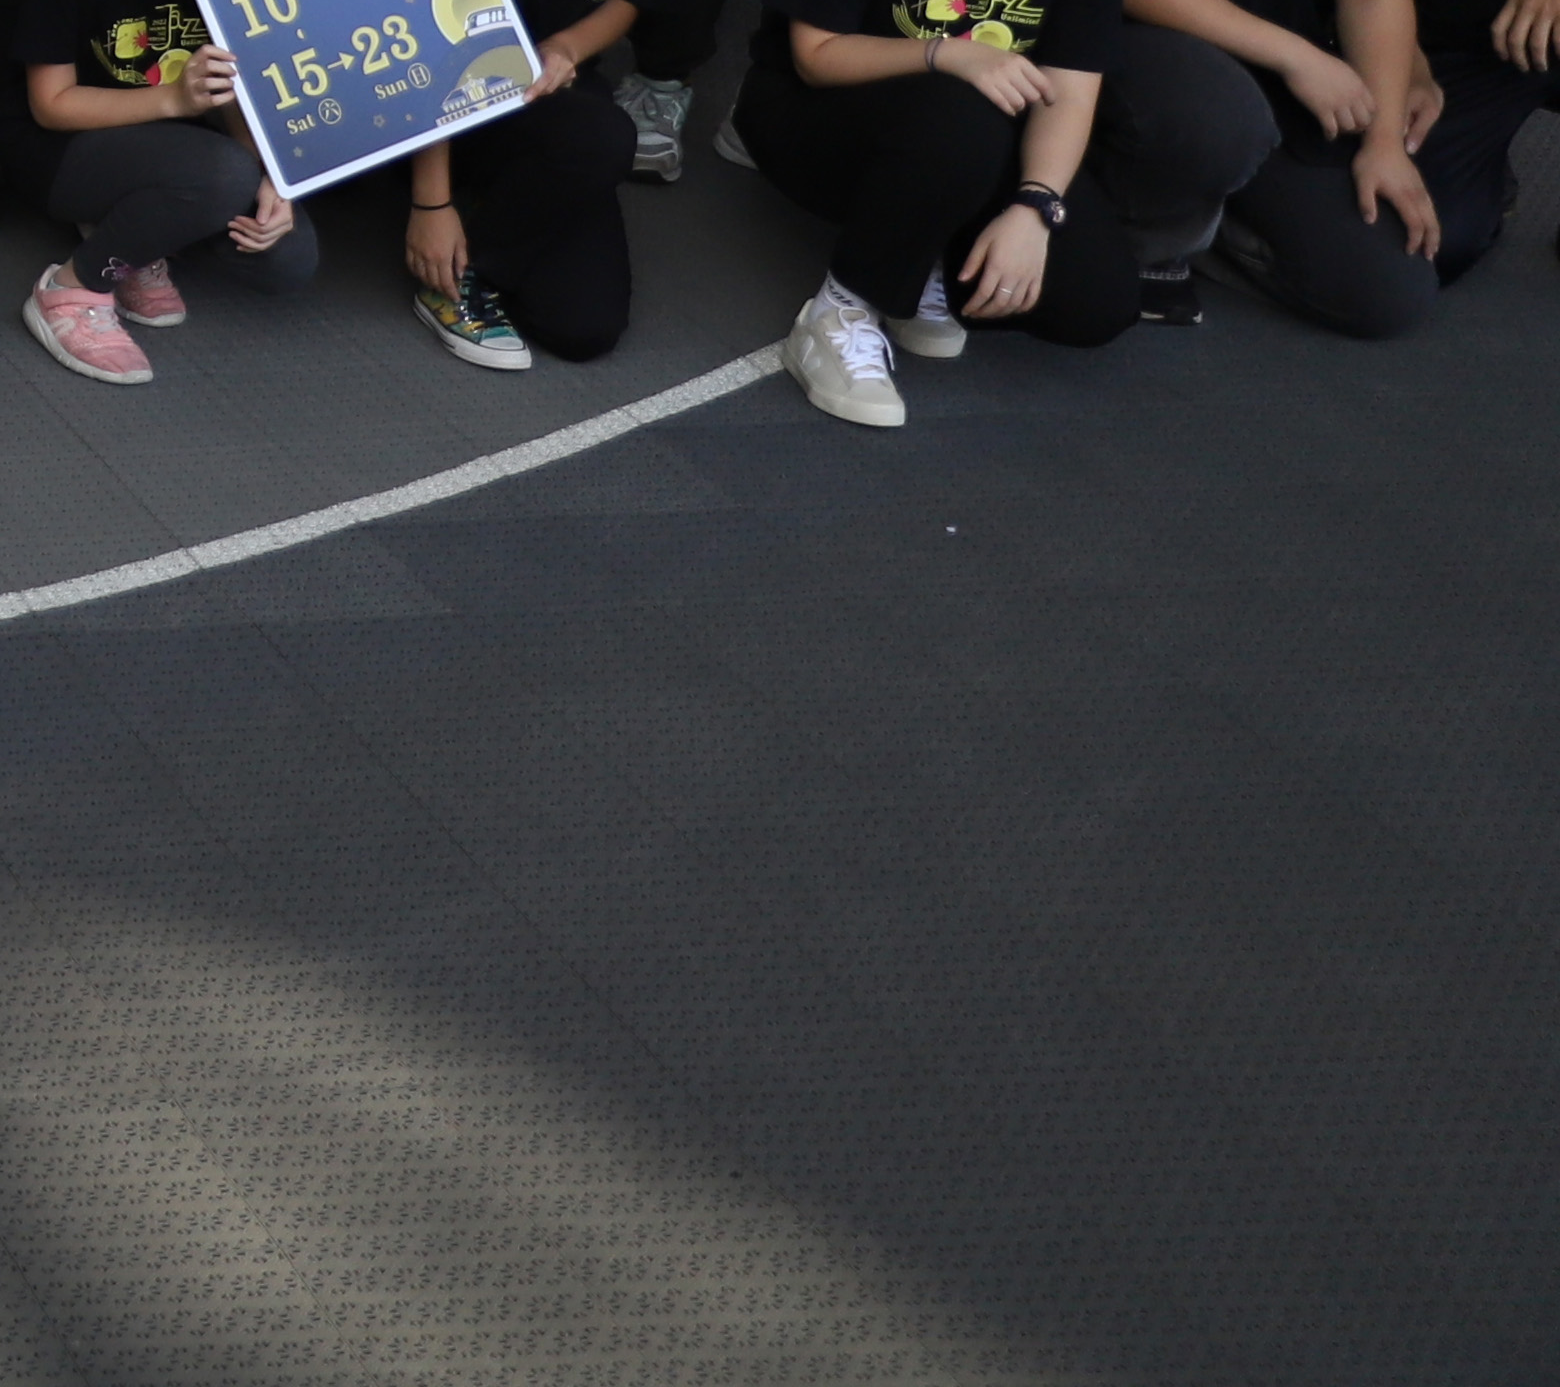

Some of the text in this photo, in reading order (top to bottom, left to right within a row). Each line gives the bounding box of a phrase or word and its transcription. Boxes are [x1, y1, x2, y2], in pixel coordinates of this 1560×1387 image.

[261, 15, 420, 114] 15 23
[373, 74, 408, 101] Sun
[285, 113, 317, 137] Sat
